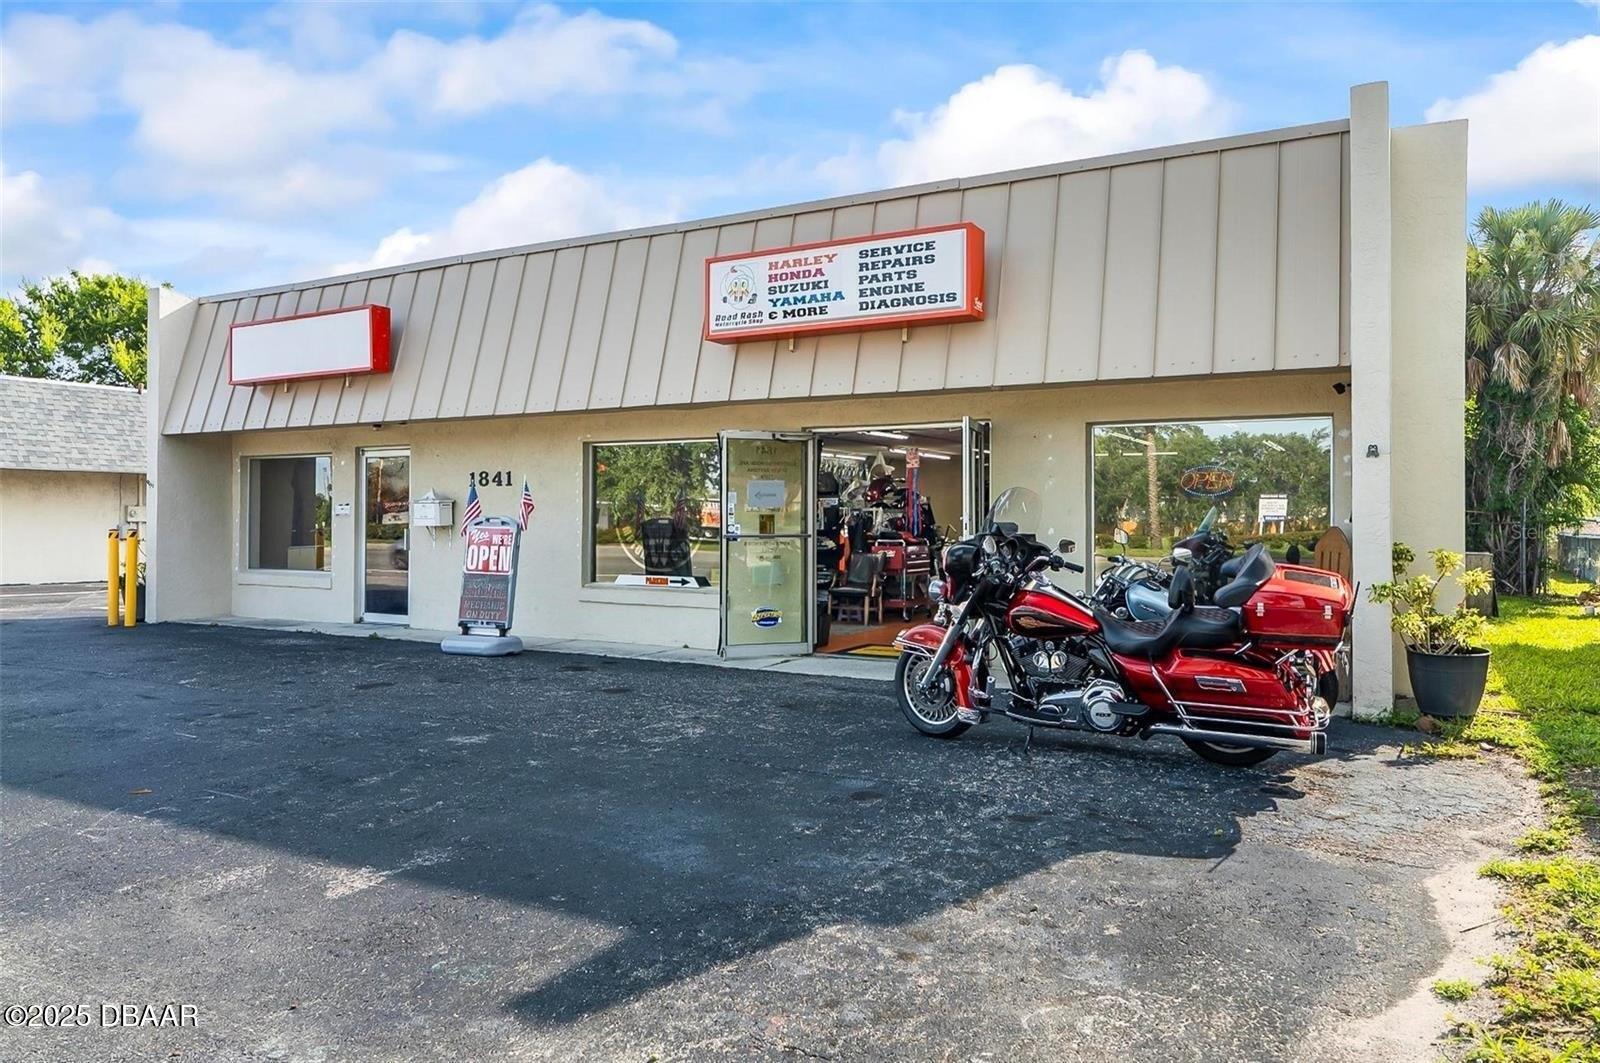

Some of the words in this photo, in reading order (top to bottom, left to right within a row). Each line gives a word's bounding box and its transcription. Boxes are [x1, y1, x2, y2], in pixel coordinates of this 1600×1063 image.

[858, 240, 936, 259] SERVICE
[768, 253, 838, 271] HARLEY
[858, 254, 935, 272] REPAIRS
[768, 267, 825, 283] HONDA
[858, 269, 917, 285] PARTS
[768, 280, 829, 295] SUZUKI
[858, 282, 925, 299] ENGINE
[768, 290, 845, 307] YAMAHA
[858, 292, 957, 311] DIAGNOSIS
[715, 313, 738, 322] Road
[740, 310, 764, 320] Rash
[782, 305, 828, 319] MORE
[469, 470, 512, 487] 1841
[1181, 471, 1235, 489] OPEN
[470, 528, 490, 544] Yes
[467, 544, 511, 571] OPEN
